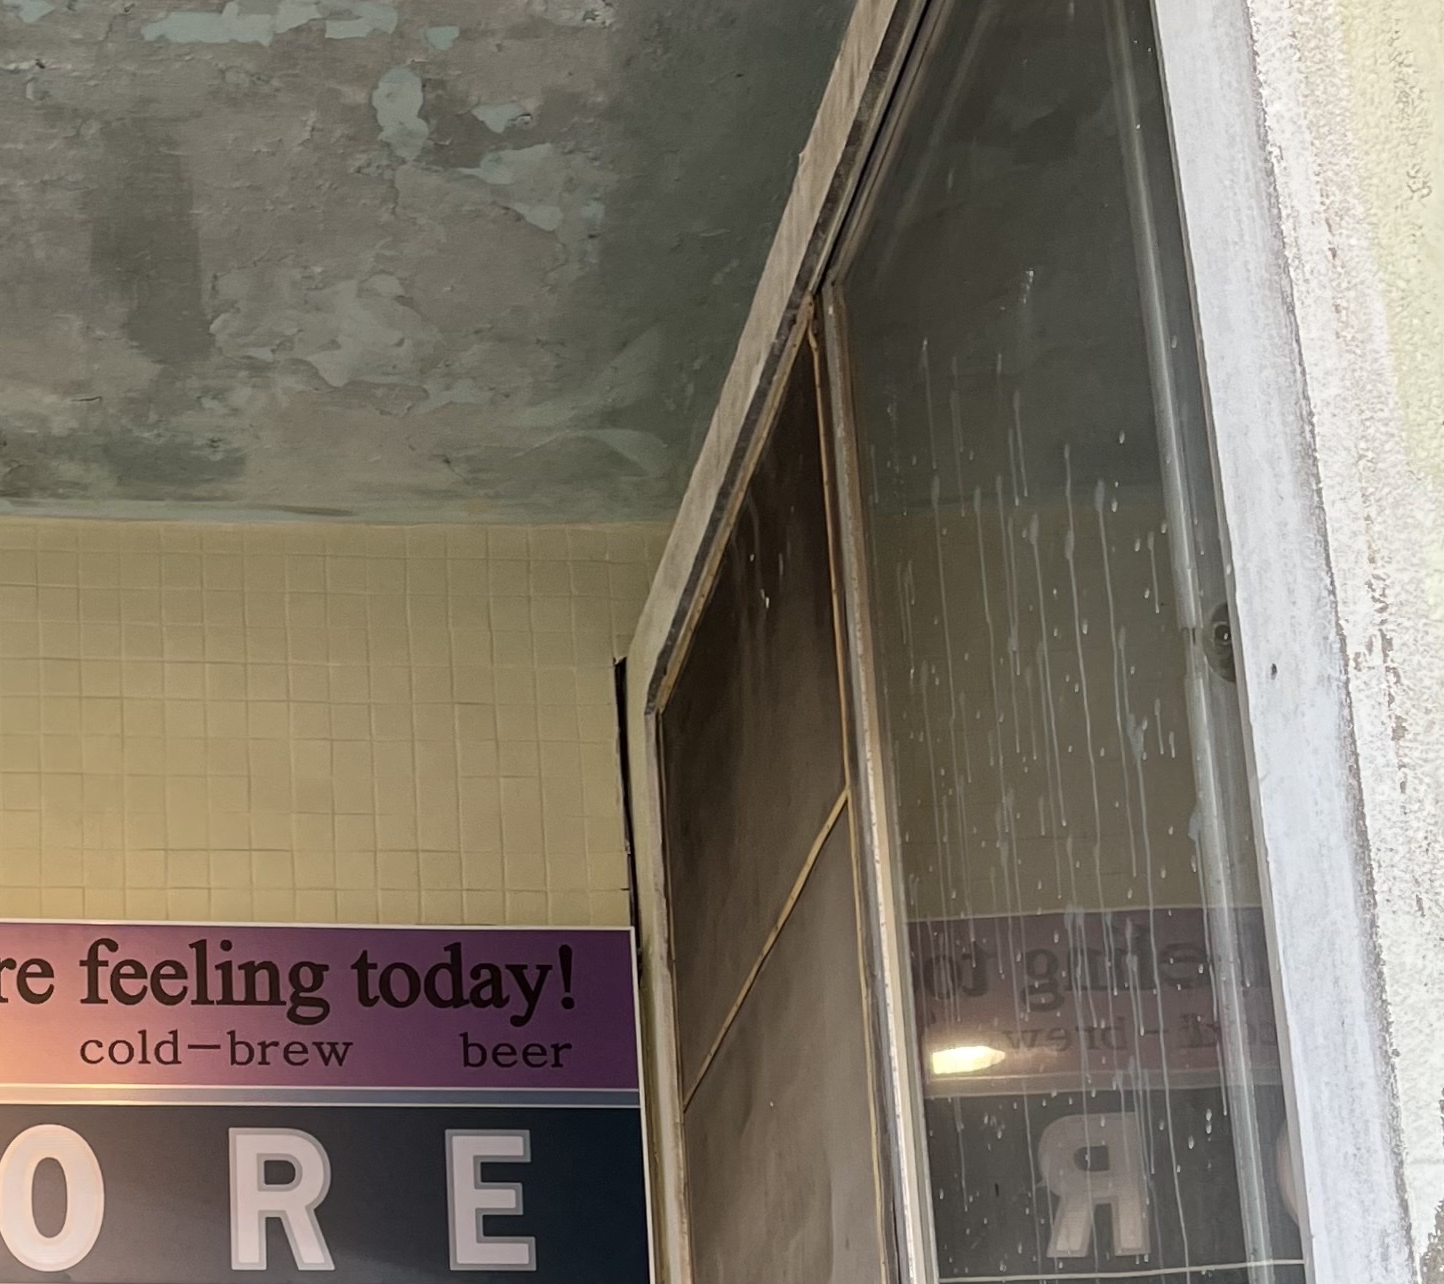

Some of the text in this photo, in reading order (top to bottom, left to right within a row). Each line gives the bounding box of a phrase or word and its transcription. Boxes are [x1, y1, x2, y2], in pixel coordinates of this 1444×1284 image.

[79, 937, 331, 1026] feeling
[349, 943, 577, 1027] today!
[78, 1029, 354, 1068] cold-brew
[459, 1032, 573, 1069] beer
